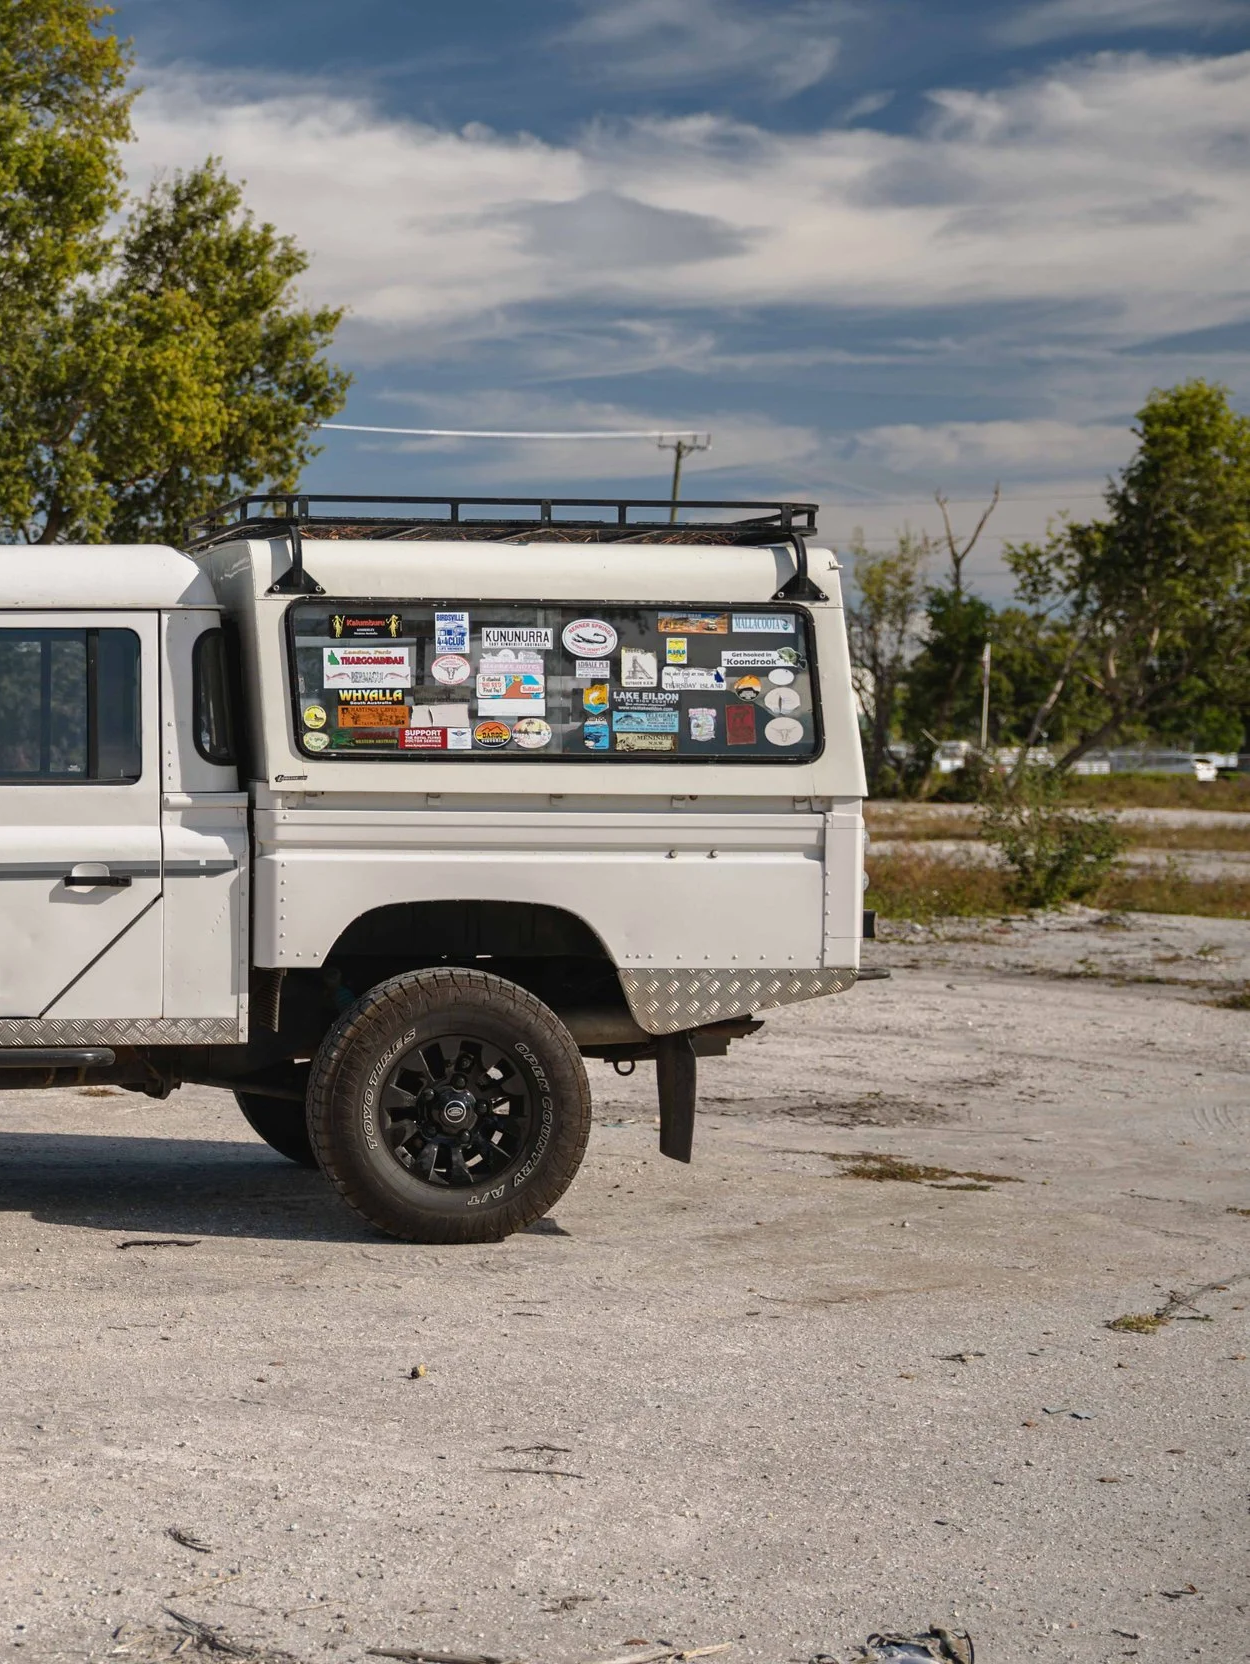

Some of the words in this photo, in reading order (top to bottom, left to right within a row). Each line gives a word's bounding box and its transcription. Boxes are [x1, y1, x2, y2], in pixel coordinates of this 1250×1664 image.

[735, 617, 780, 630] MALLACOOTA
[485, 630, 550, 643] KUNUNURRA
[340, 656, 405, 665] THARGOMINDAH
[338, 689, 403, 701] WHYALLA
[613, 691, 640, 700] LAKE
[642, 692, 679, 701] EILDON
[368, 1028, 416, 1086] TIRES
[514, 1042, 550, 1092] OPEN
[362, 1088, 378, 1150] TOYO
[513, 1096, 554, 1188] COUNTRY
[467, 1184, 505, 1206] A/T
